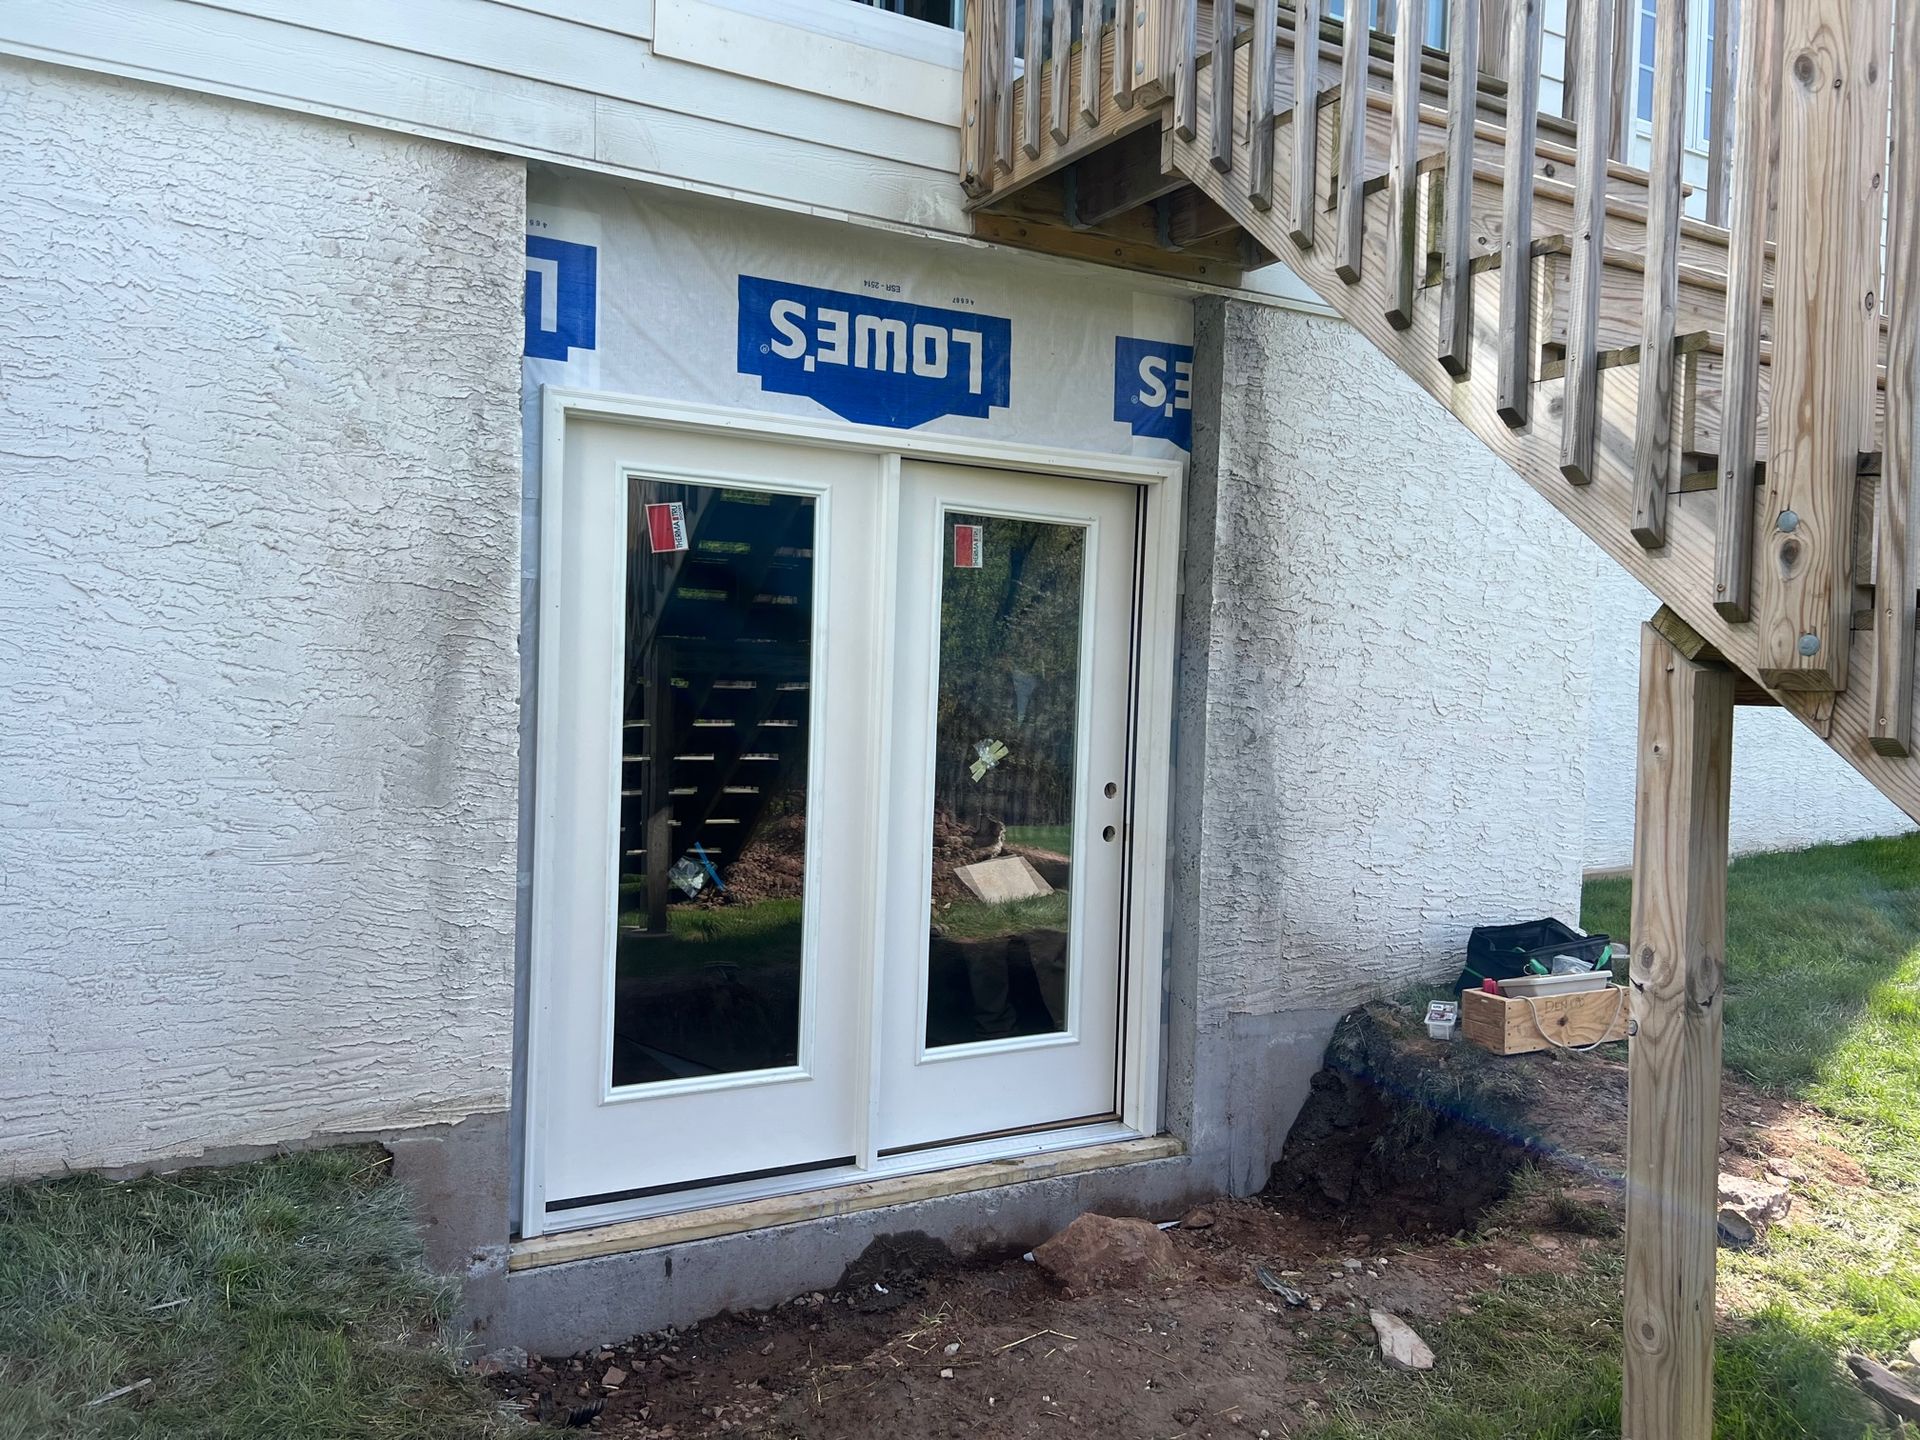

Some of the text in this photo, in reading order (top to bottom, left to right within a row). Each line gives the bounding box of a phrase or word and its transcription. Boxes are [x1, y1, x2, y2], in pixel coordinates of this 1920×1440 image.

[863, 280, 880, 290] 2514
[885, 284, 901, 293] ESR
[769, 298, 983, 395] LOWE'S
[1138, 355, 1193, 418] E'S
[673, 520, 683, 549] THERMA
